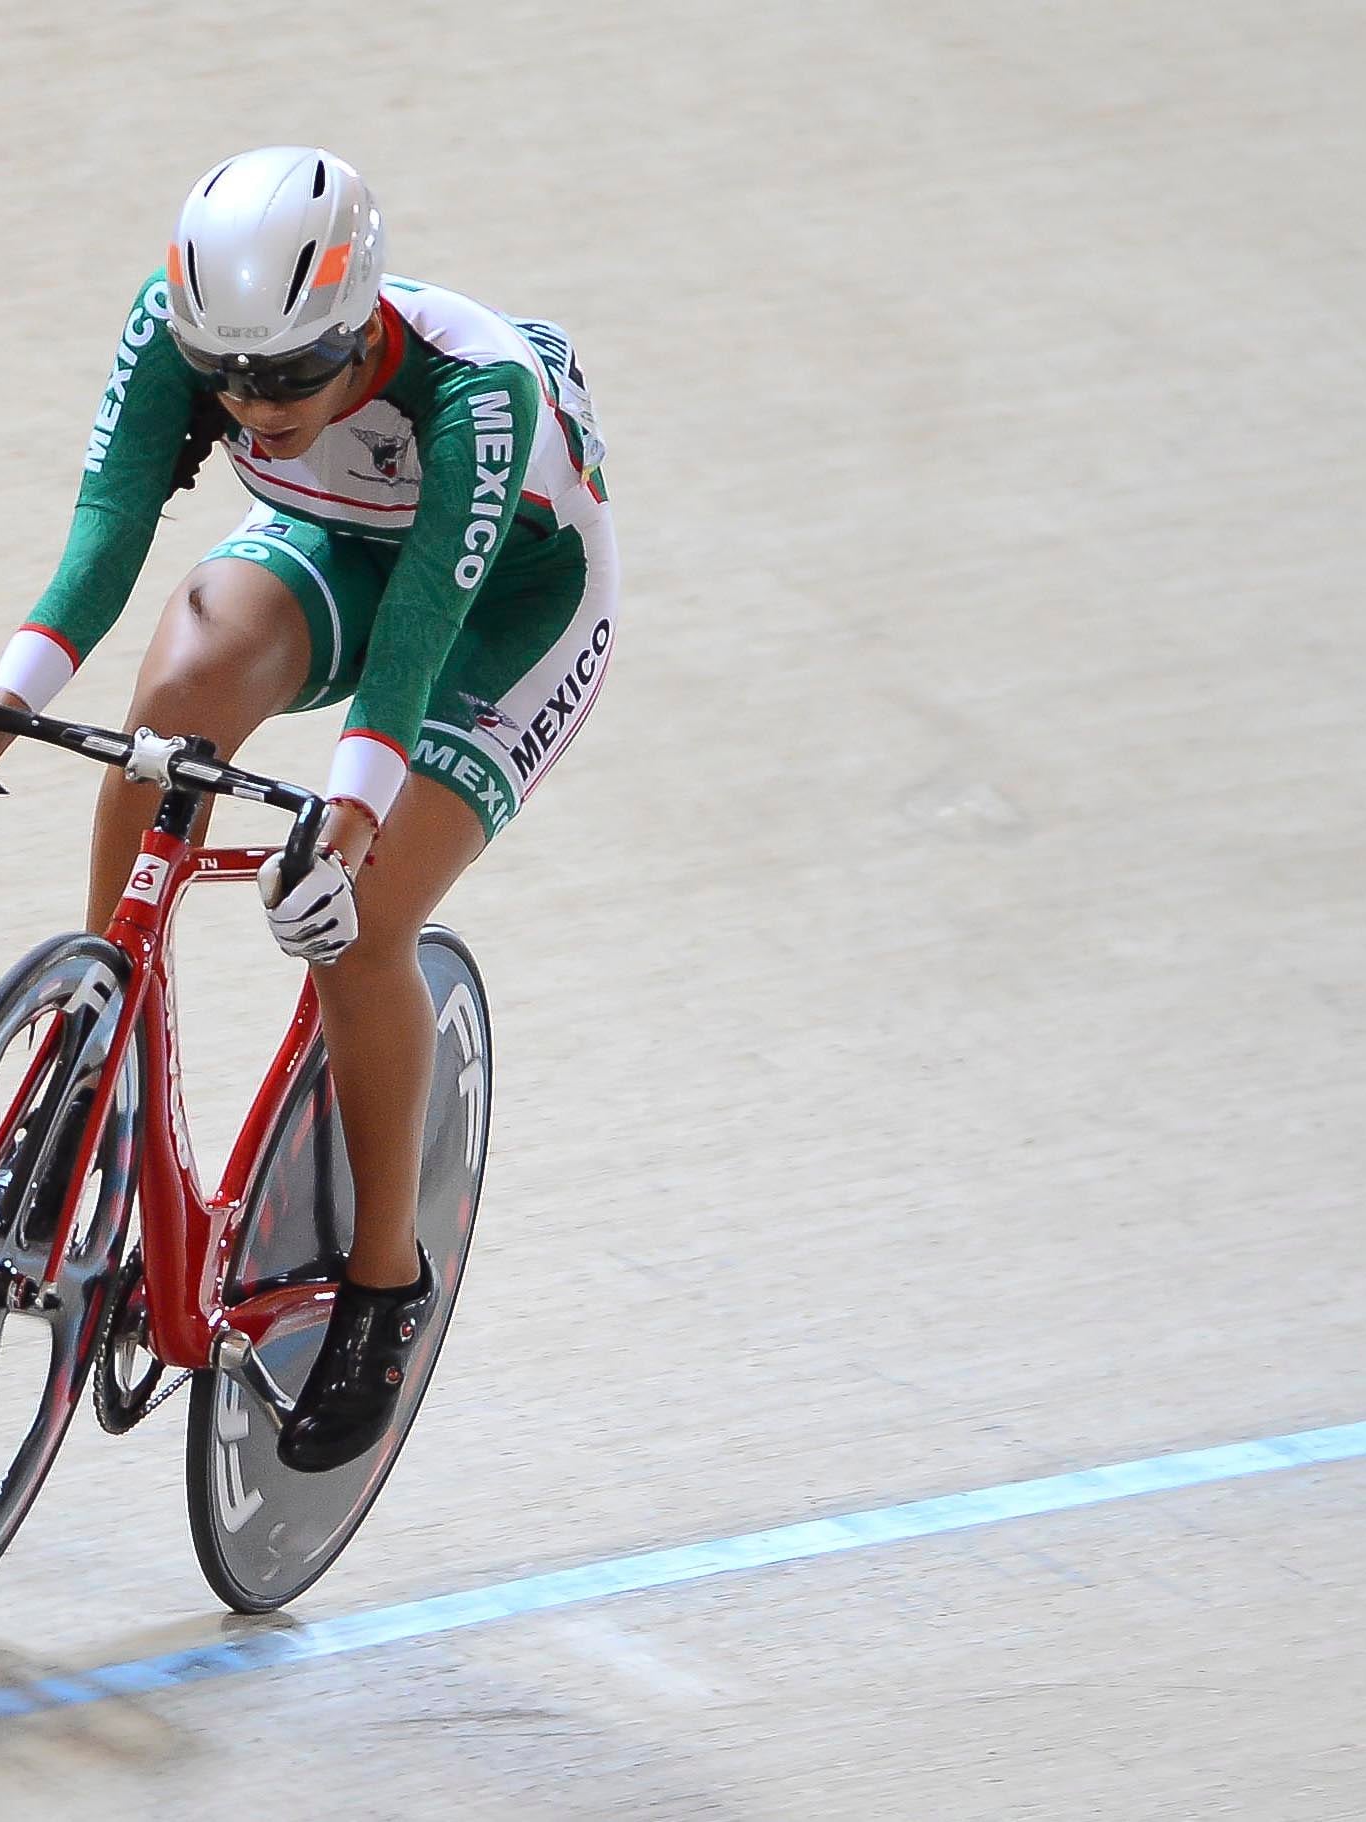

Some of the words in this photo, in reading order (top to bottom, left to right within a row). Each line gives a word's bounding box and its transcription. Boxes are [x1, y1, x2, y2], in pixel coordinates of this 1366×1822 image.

[84, 279, 172, 474] MEXICO
[454, 390, 514, 590] MEXICO
[509, 617, 611, 782] MEXICO
